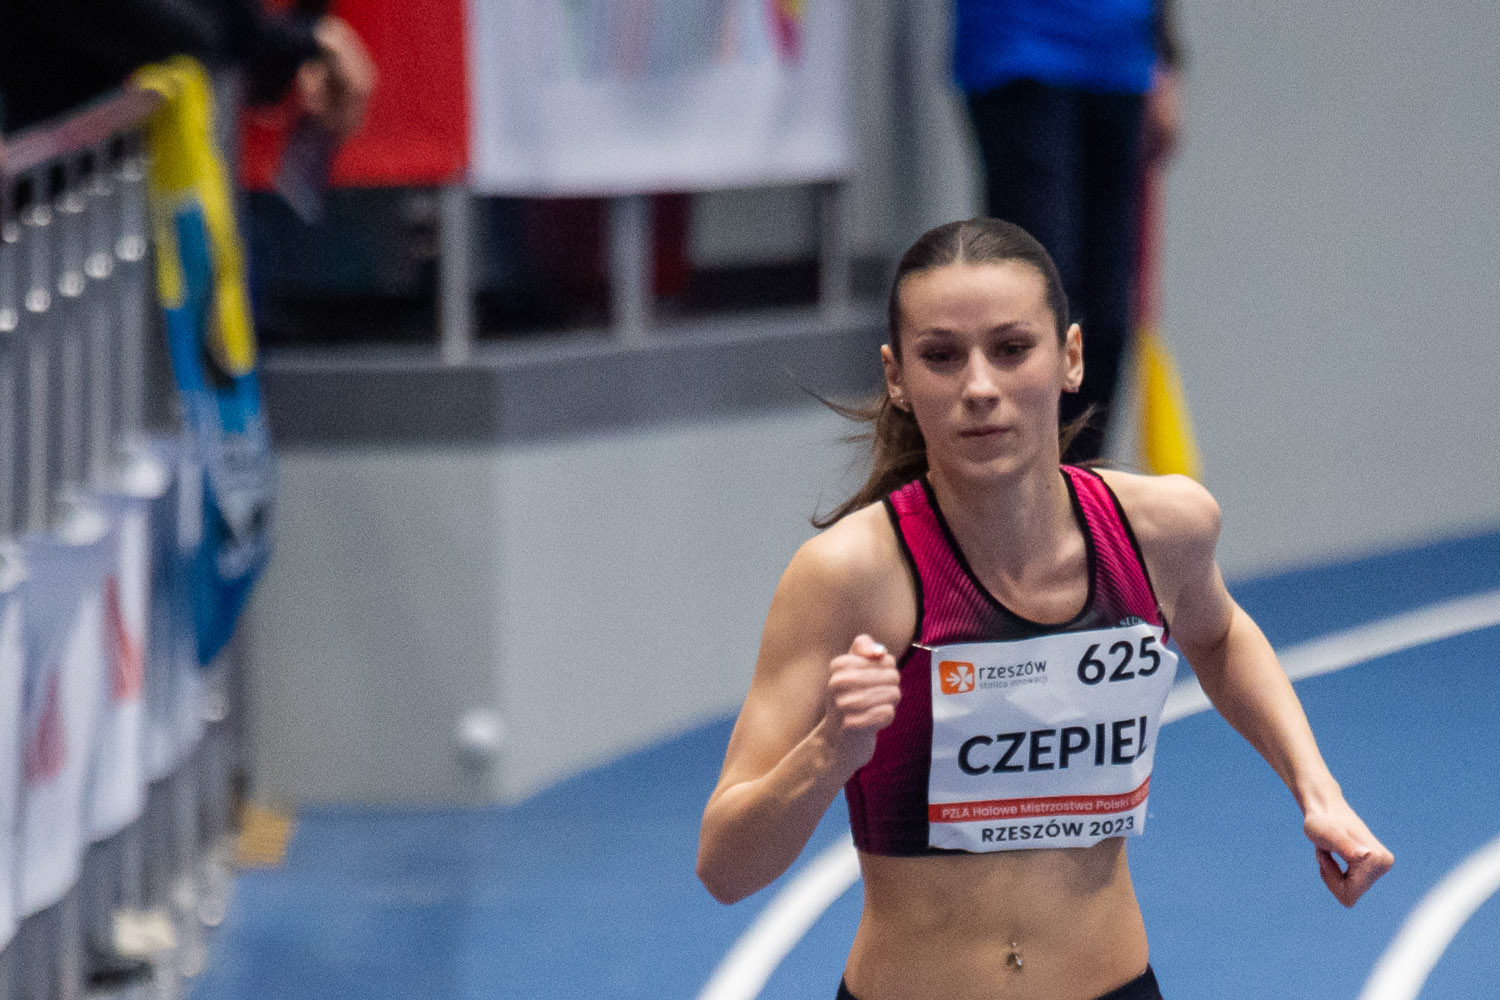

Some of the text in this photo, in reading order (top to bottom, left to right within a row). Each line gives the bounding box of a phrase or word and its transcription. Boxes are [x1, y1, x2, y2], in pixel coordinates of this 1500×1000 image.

[979, 660, 1046, 680] rzeszów
[1077, 635, 1161, 685] 625
[942, 808, 970, 820] PZLA
[973, 806, 1018, 817] Halowe
[1021, 801, 1093, 814] Mistrzostwa
[981, 816, 1134, 843] RZESZÓW 2023
